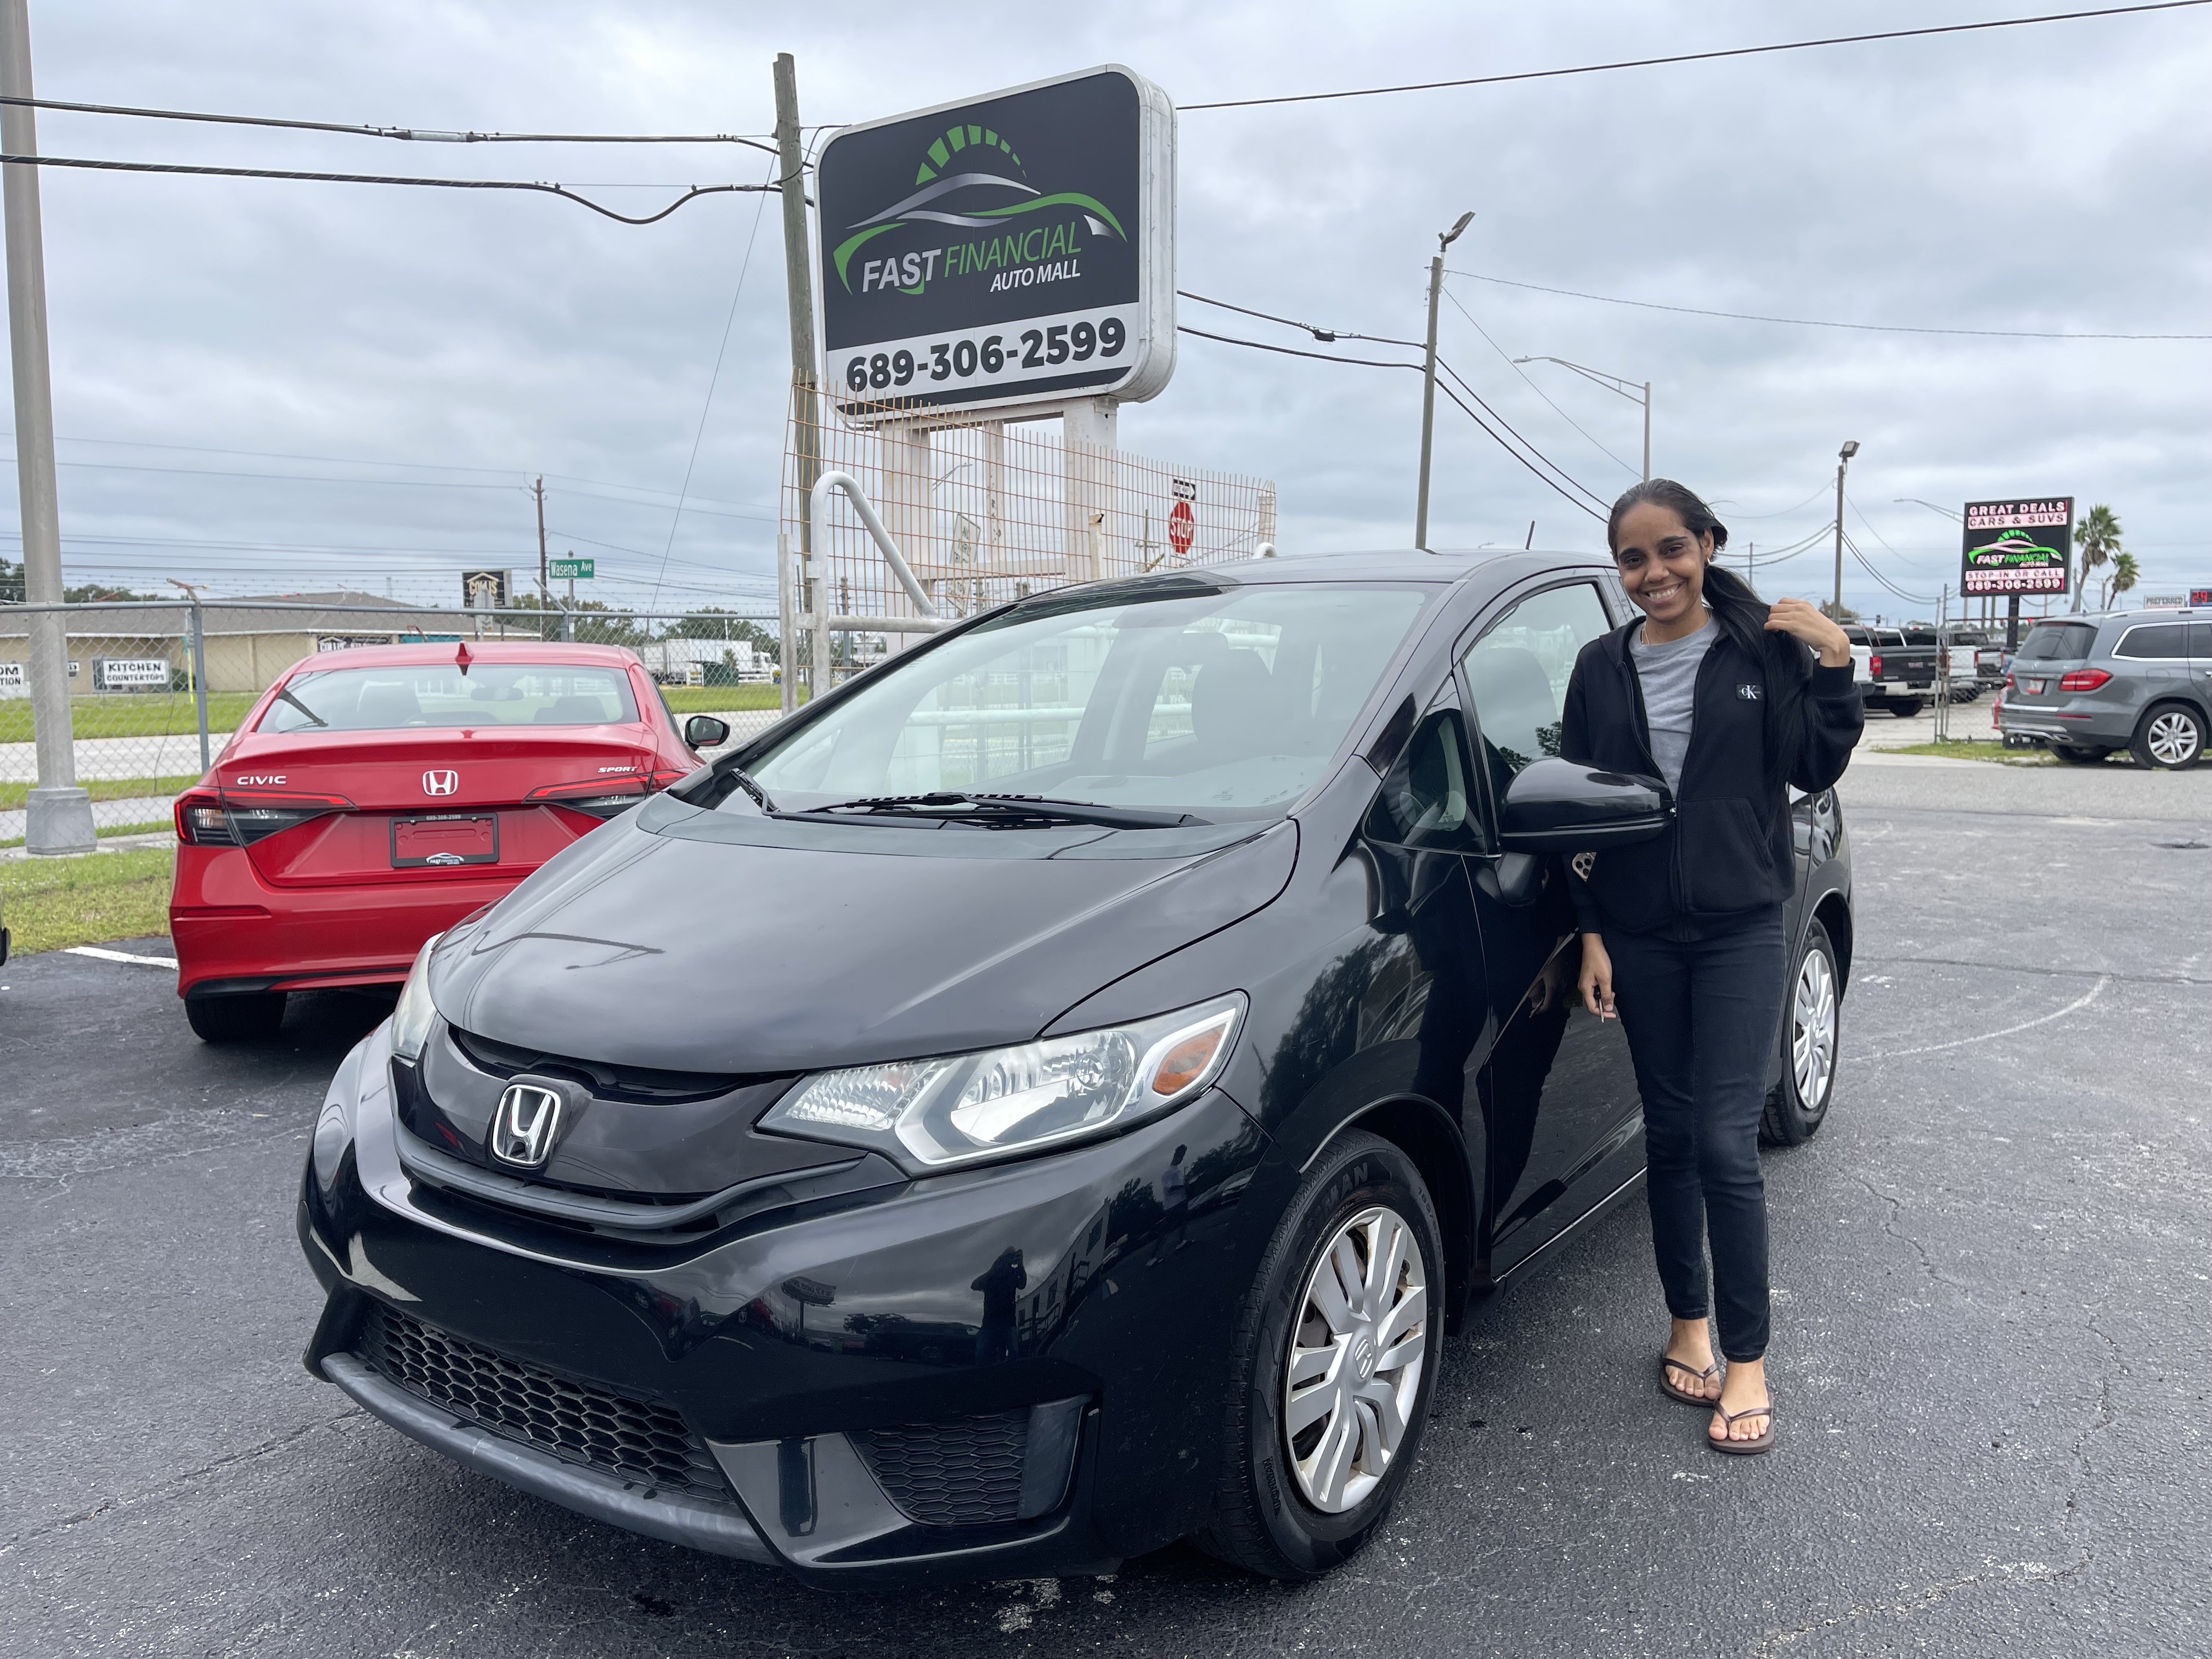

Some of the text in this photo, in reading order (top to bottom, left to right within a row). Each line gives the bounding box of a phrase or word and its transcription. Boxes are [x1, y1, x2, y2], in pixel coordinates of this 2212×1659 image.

[861, 221, 1082, 293] FAST FINANCIAL
[990, 258, 1081, 293] AUTO MALL
[846, 317, 1126, 393] 689-306-2599
[1968, 501, 2066, 516] GREAT DEALS
[1170, 516, 1193, 539] STOP
[1969, 514, 2064, 527] CARS & SUVS
[1976, 554, 2005, 565] FAST
[550, 561, 592, 577] Wasena Ave
[109, 663, 161, 672] KITCHEN
[236, 775, 287, 785] CIVIC
